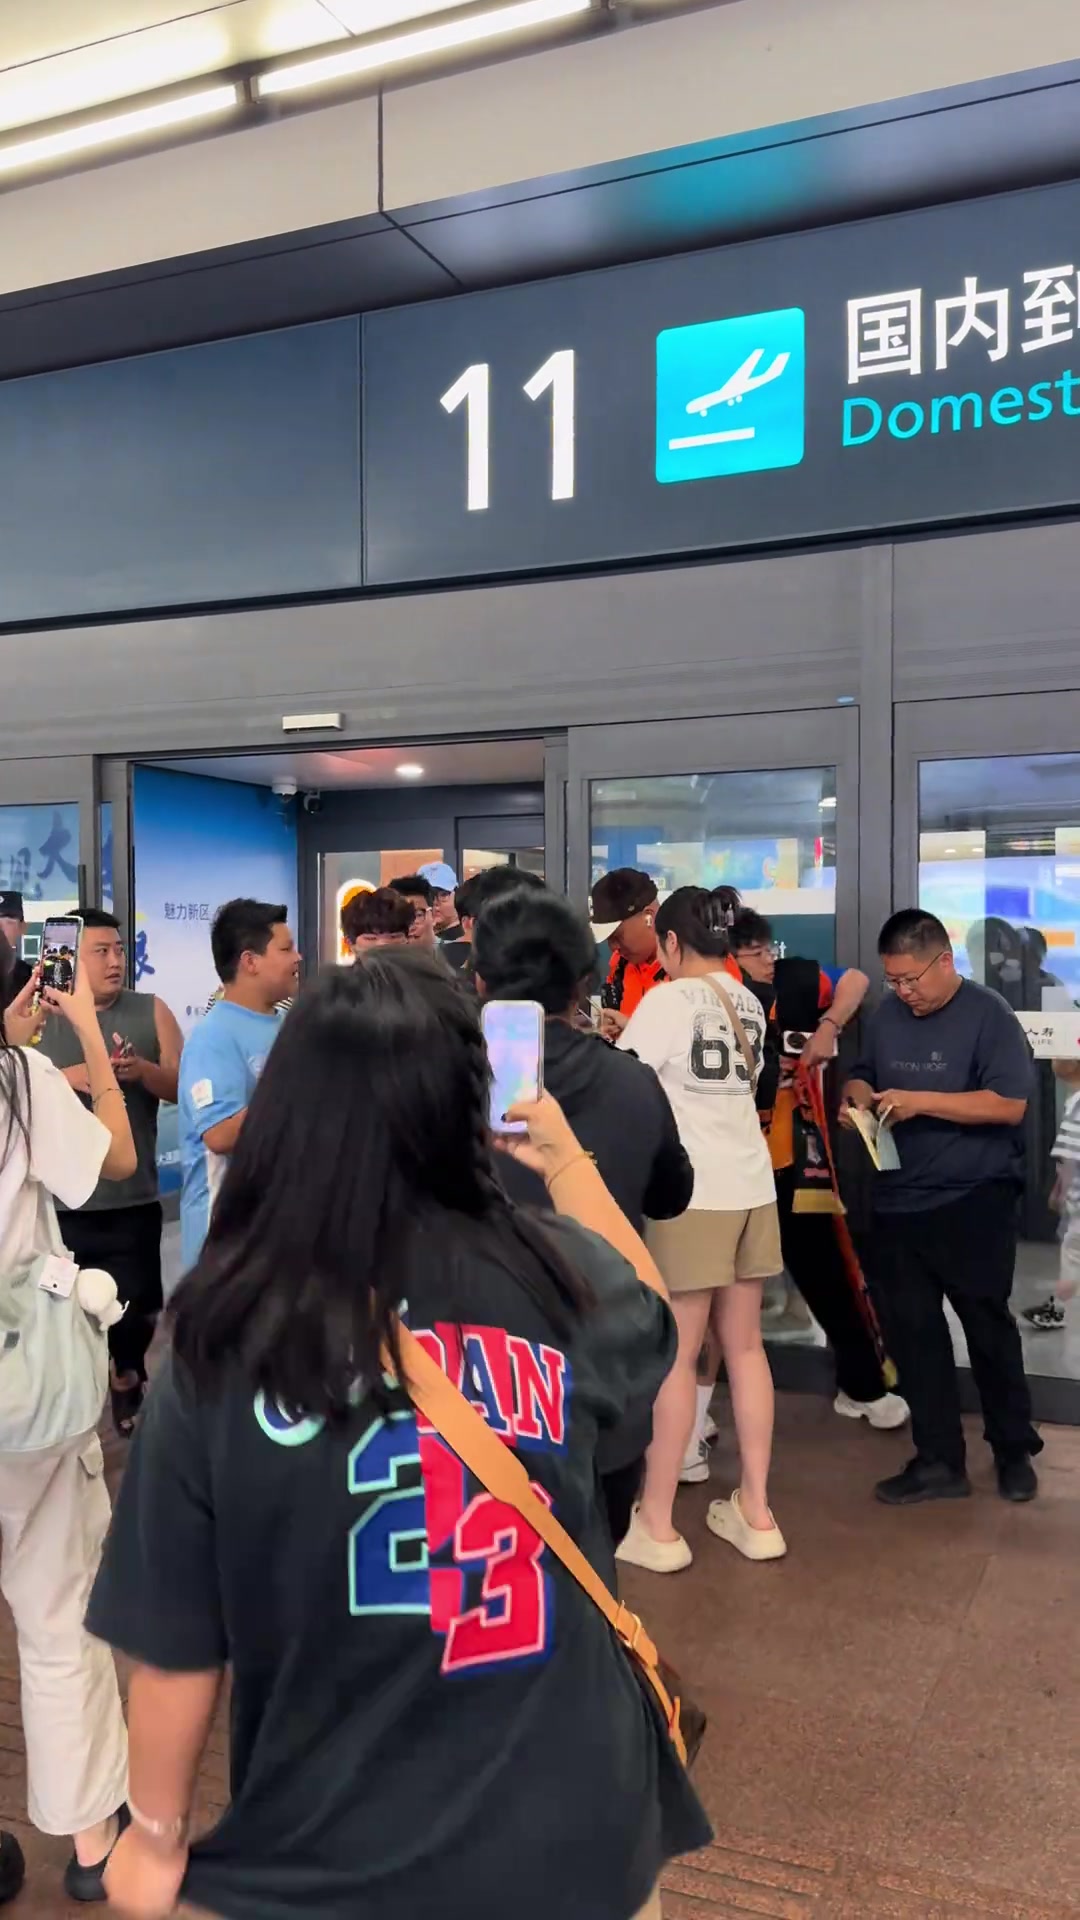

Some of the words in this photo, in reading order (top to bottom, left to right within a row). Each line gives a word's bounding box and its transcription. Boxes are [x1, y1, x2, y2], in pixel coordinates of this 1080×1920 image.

[440, 350, 576, 511] 11
[842, 369, 1080, 446] Domest
[164, 903, 210, 920] 魅力新区
[681, 989, 763, 1016] VINAGE
[348, 1411, 555, 1675] 23
